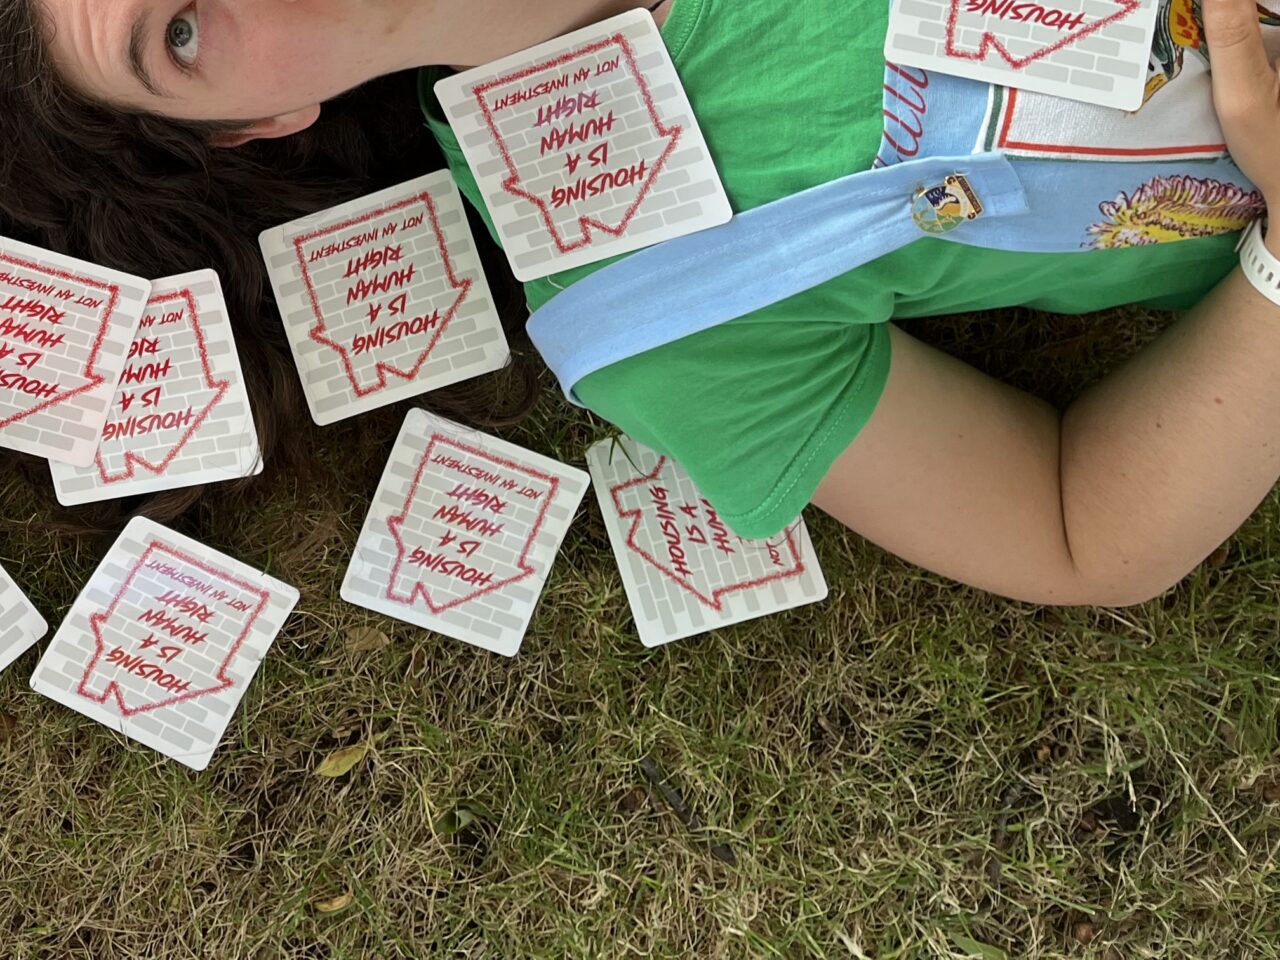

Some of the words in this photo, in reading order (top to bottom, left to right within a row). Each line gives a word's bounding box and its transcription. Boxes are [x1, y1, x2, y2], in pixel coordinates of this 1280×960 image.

[571, 66, 591, 83] AN
[593, 57, 620, 77] NOT
[492, 73, 570, 112] INVESTMENT
[533, 90, 600, 128] RIGHT
[538, 110, 615, 156] HUMAN
[564, 152, 581, 175] A
[585, 141, 609, 167] IS
[549, 159, 649, 209] HOUSING
[380, 221, 398, 237] AN
[400, 213, 424, 232] NOT
[307, 227, 379, 263] INVESTMENT
[342, 244, 403, 278] RIGHT
[54, 287, 74, 301] AN
[345, 262, 415, 305] HUMAN
[73, 294, 101, 308] NOT
[366, 302, 383, 324] A
[386, 291, 408, 316] IS
[350, 308, 440, 355] HOUSING
[16, 351, 43, 370] IS
[430, 454, 501, 485] INVESTMENT
[498, 477, 517, 491] AN
[515, 485, 541, 499] NOT
[446, 483, 507, 515] RIGHT
[432, 504, 504, 538] HUMAN
[437, 529, 458, 548] A
[456, 539, 482, 558] IS
[407, 545, 494, 587] HOUSING
